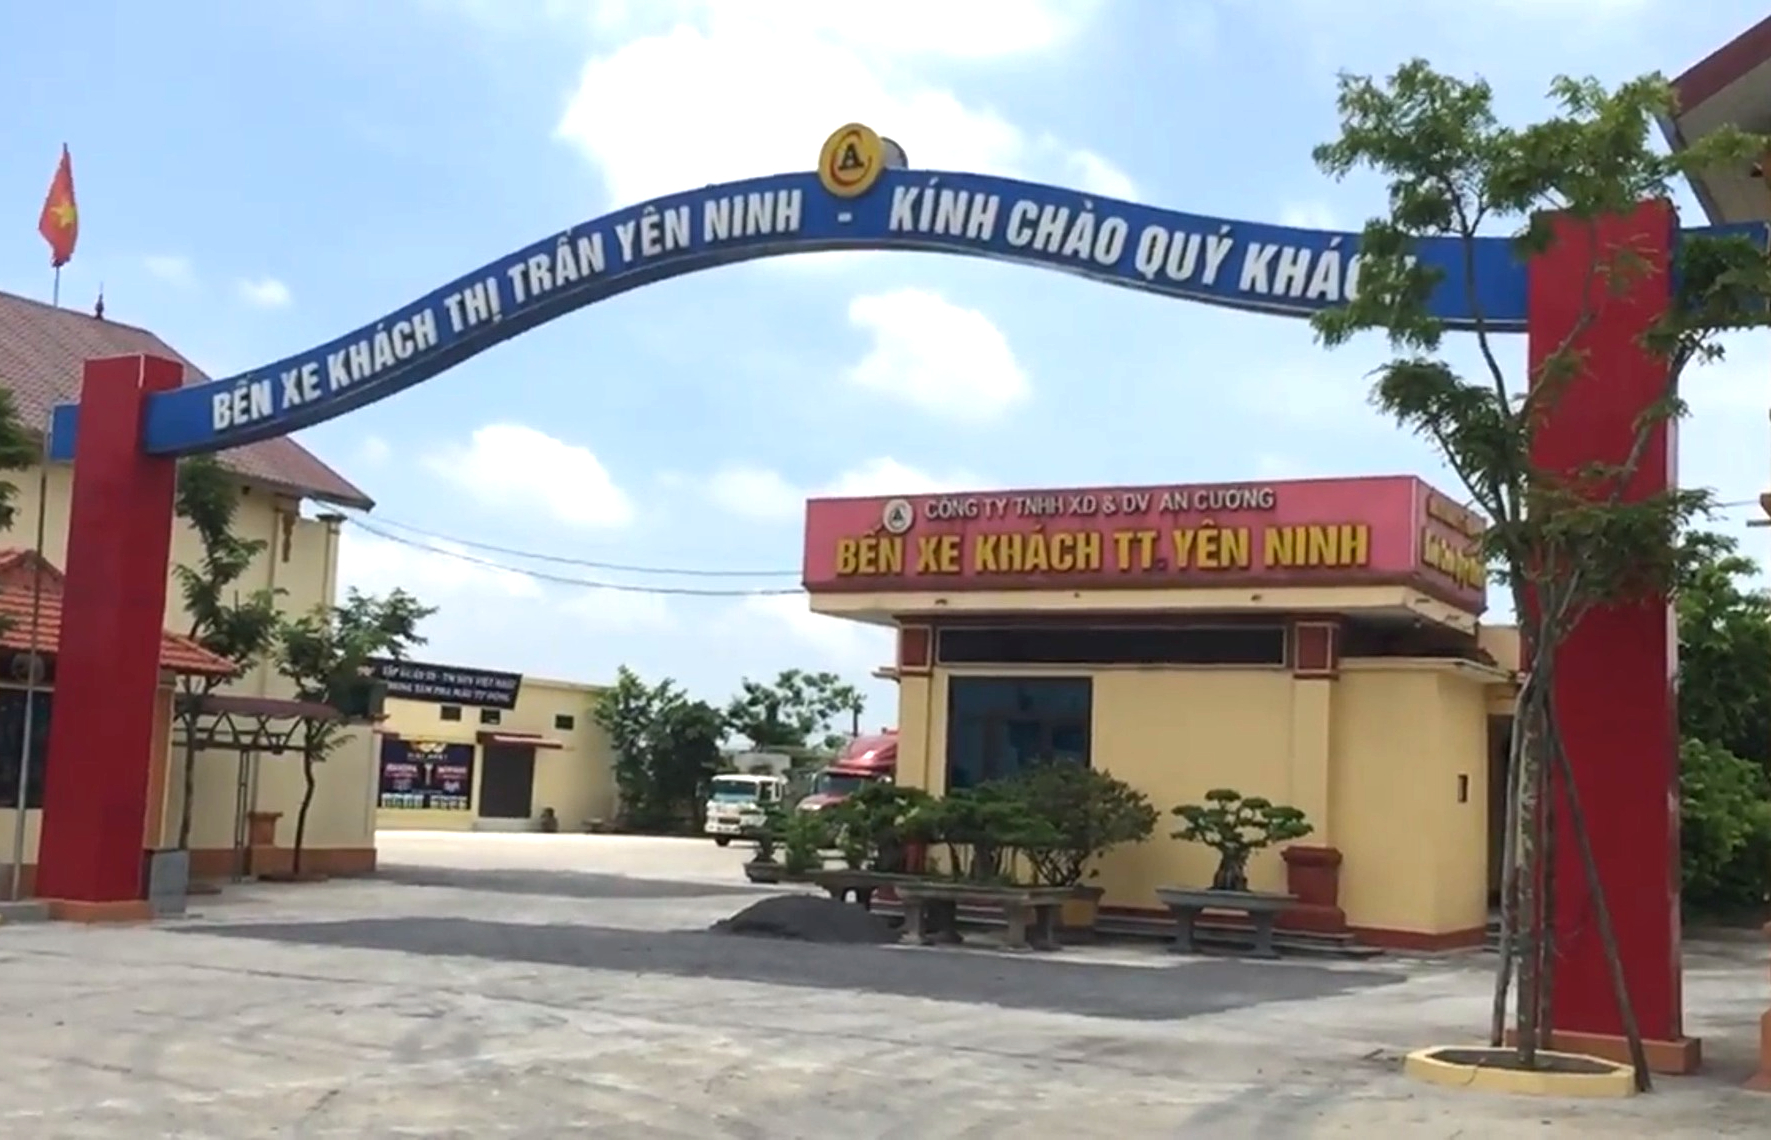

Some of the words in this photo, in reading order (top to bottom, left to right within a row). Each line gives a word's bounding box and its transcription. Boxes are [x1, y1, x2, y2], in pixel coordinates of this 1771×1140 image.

[212, 374, 274, 431] BẾN
[280, 361, 322, 409] XE
[326, 308, 438, 392] KHÁCH
[443, 277, 502, 324] THỊ
[507, 226, 605, 304] TRẤN
[614, 206, 690, 262] YÊN
[703, 189, 802, 242] NINH
[888, 177, 1000, 241] KÍNH
[1006, 199, 1128, 266] CHÀO
[1134, 225, 1235, 286] QUÝ
[1239, 237, 1416, 305] KHÁC
[925, 496, 978, 519] CÔNG
[984, 499, 1010, 517] TY
[1015, 497, 1063, 516] TNHH
[1069, 495, 1096, 515] XD
[1103, 495, 1116, 514] &
[1123, 493, 1151, 513] DV
[1159, 491, 1188, 511] AN
[836, 523, 903, 574] BẾN
[917, 535, 960, 573] XE
[974, 525, 1100, 572] KHÁCH
[1173, 519, 1250, 569] YÊN
[1264, 524, 1368, 568] NINH
